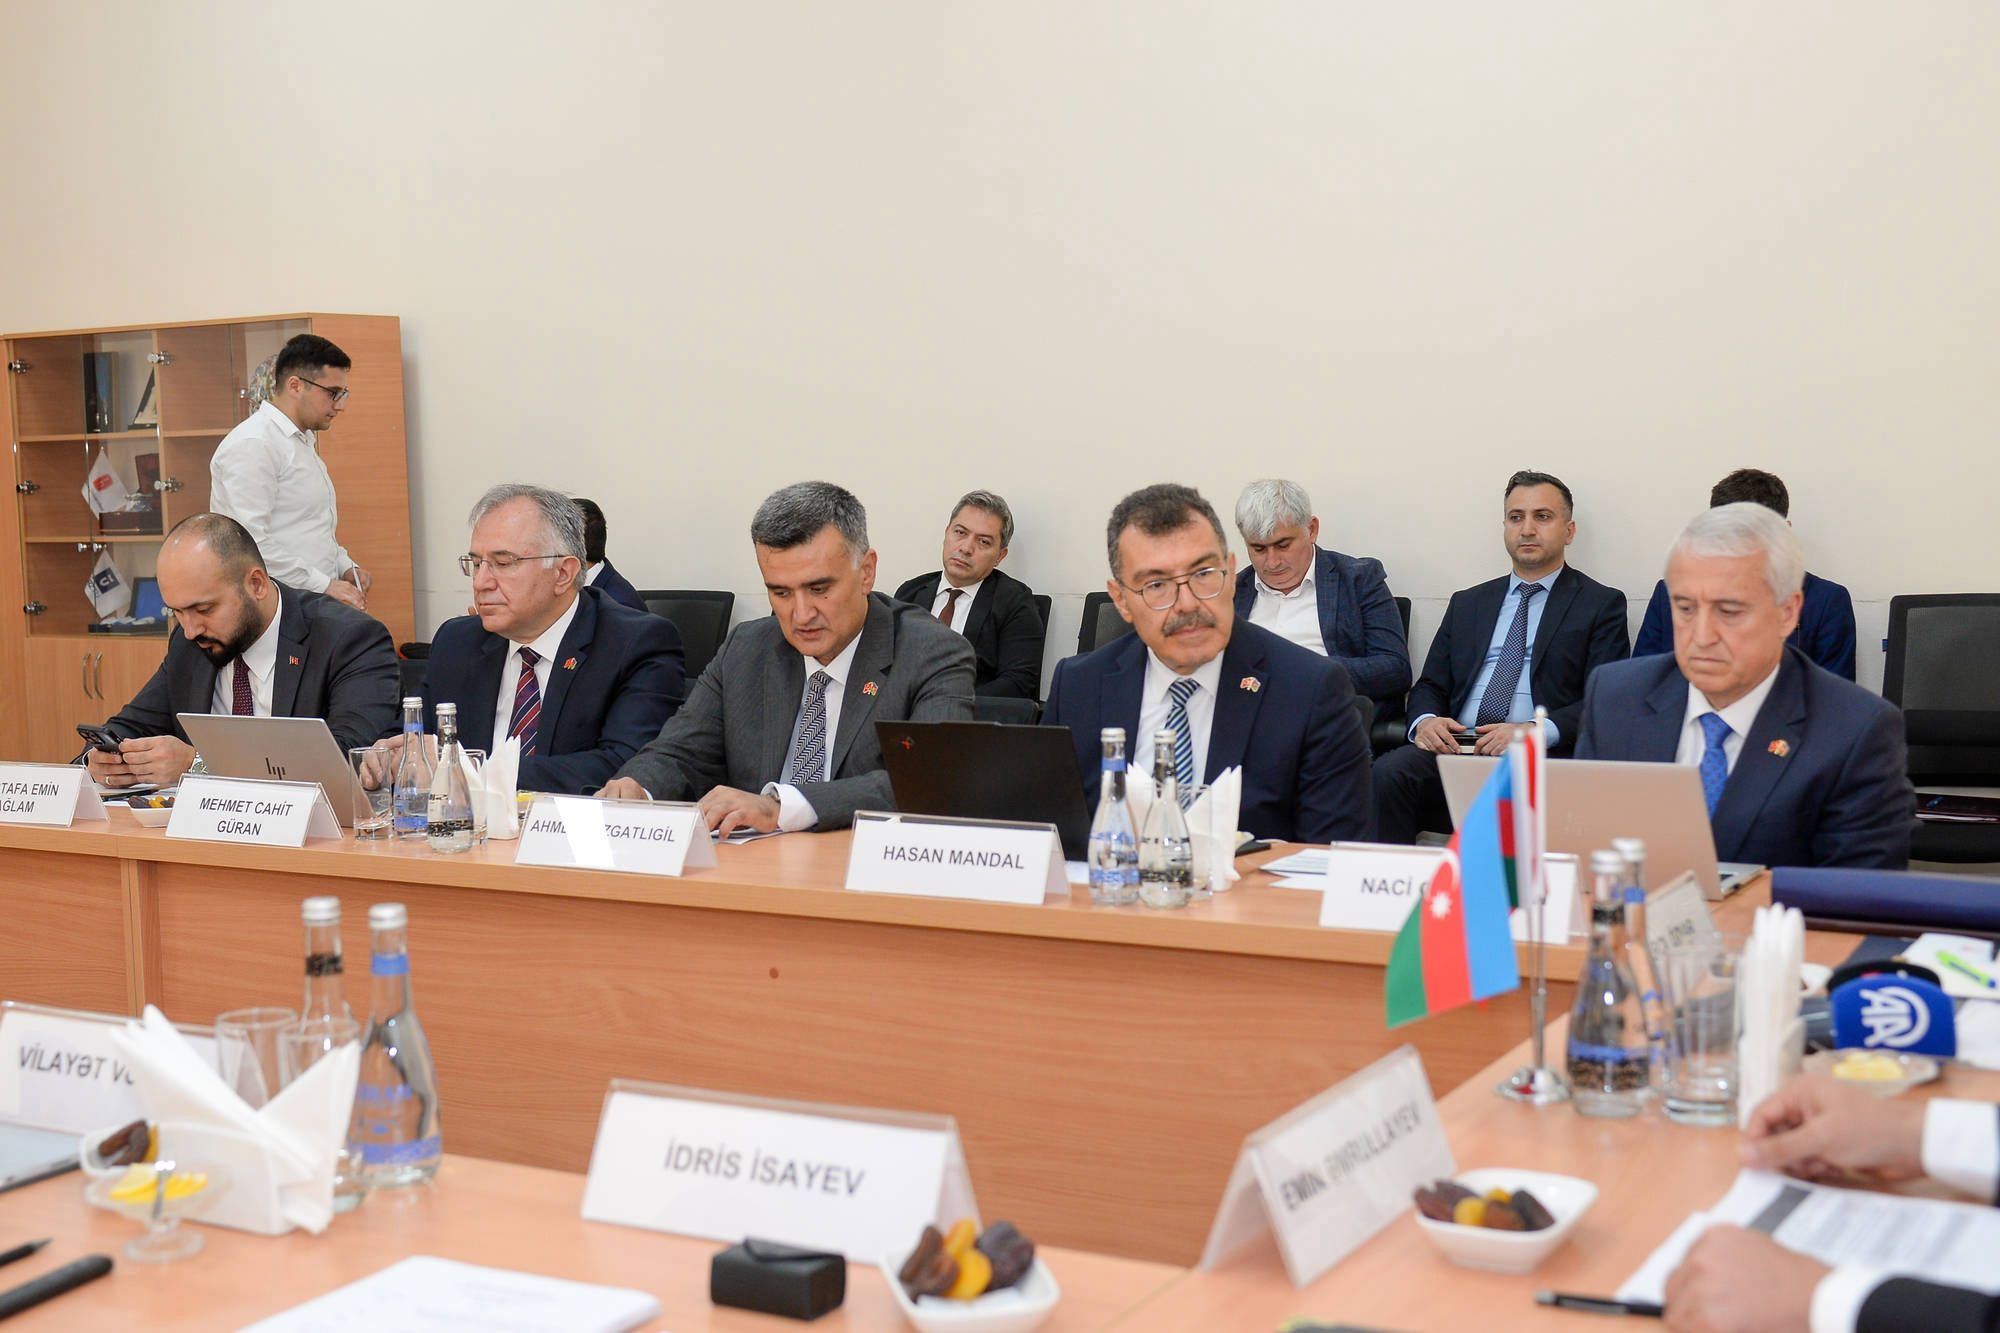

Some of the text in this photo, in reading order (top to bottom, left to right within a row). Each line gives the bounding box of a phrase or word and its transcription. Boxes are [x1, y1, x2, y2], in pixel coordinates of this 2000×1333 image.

[0, 780, 60, 796] TAFA EMİN
[0, 797, 35, 812] ĞLAM
[199, 797, 294, 816] MEHMET CAHİT
[217, 818, 261, 836] GÜRAN
[530, 819, 567, 833] AHM
[883, 845, 1024, 869] HASAN MANDAL
[1361, 876, 1413, 896] NACİ
[20, 1042, 107, 1079] VİLAYƏT
[664, 1136, 865, 1195] İDRİS İSAYEV
